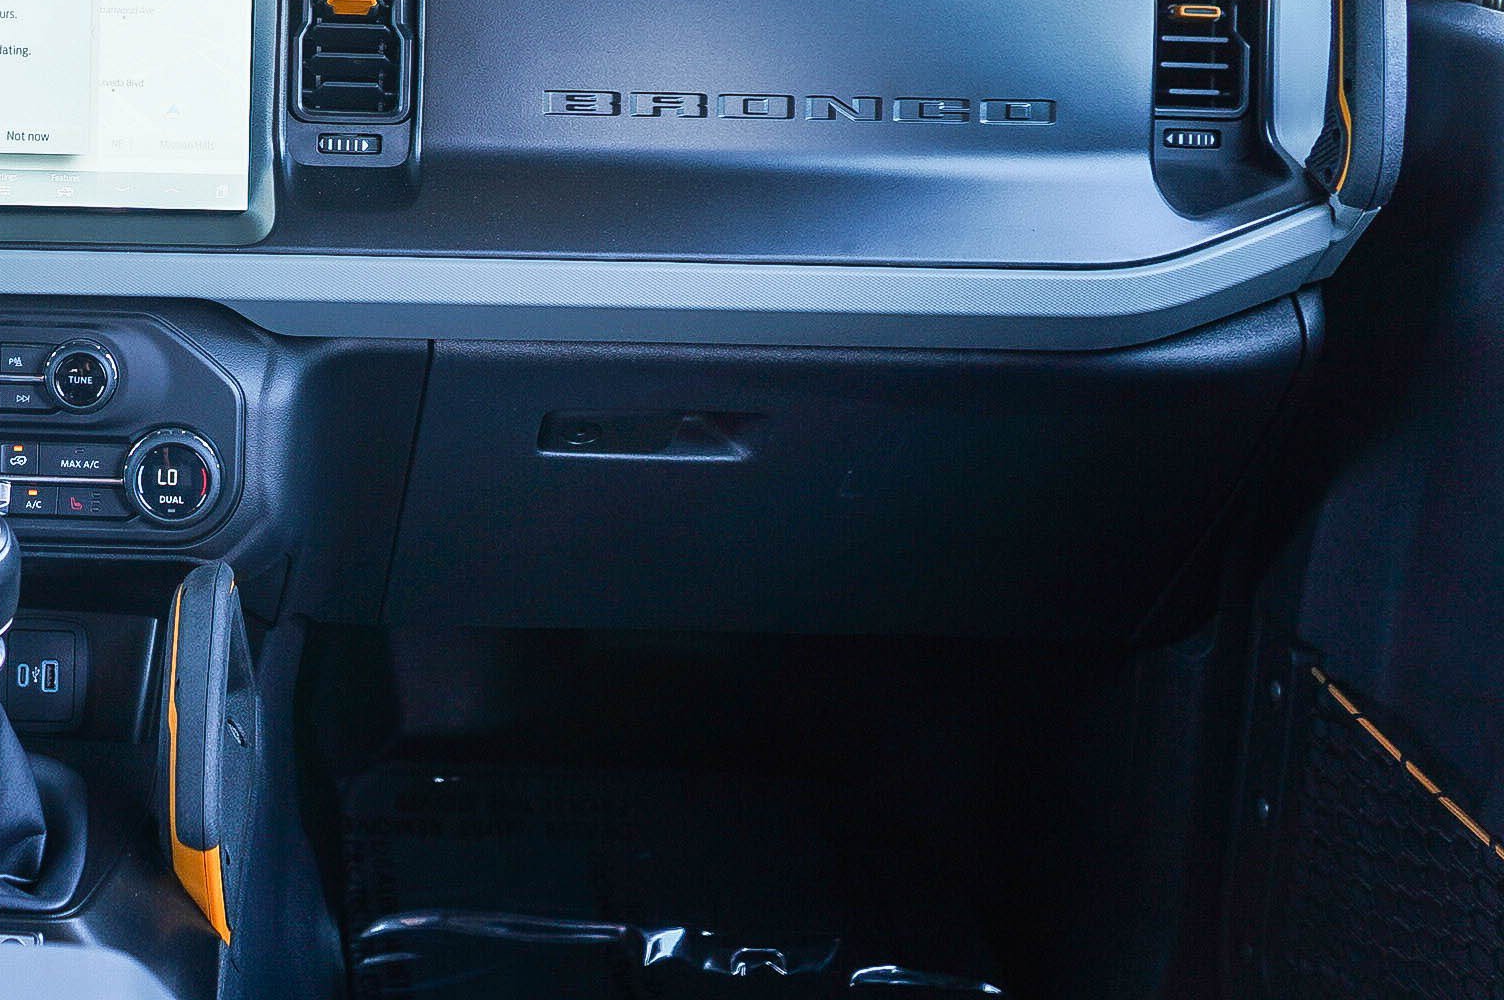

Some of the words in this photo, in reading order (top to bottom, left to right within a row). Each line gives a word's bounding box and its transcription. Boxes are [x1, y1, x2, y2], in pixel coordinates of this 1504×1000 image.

[543, 89, 1057, 126] BRONCO
[6, 130, 26, 142] Not
[27, 133, 50, 142] now
[68, 375, 93, 385] TUNE
[60, 459, 82, 468] MAX
[82, 460, 100, 469] A/C
[157, 468, 178, 486] LO
[25, 500, 42, 510] A/C
[159, 495, 184, 505] DUAL
